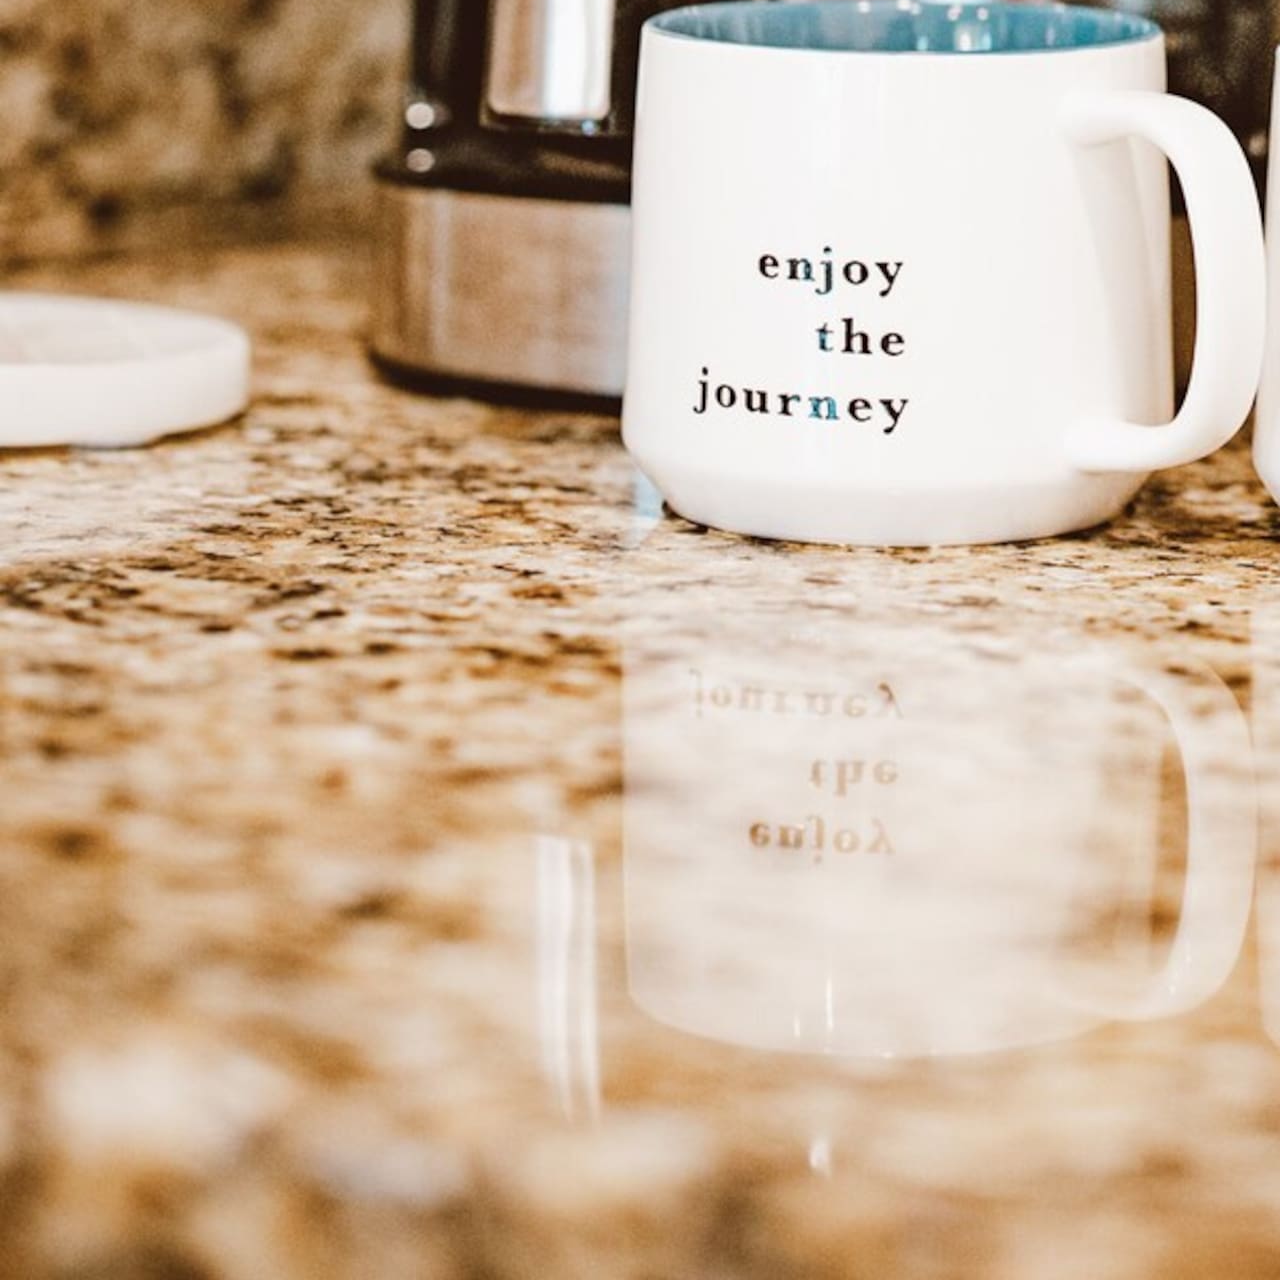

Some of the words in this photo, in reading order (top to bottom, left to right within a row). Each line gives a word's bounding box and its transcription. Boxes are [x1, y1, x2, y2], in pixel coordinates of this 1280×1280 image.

[758, 246, 903, 297] enjoy
[816, 317, 905, 356] the
[693, 367, 909, 434] journey
